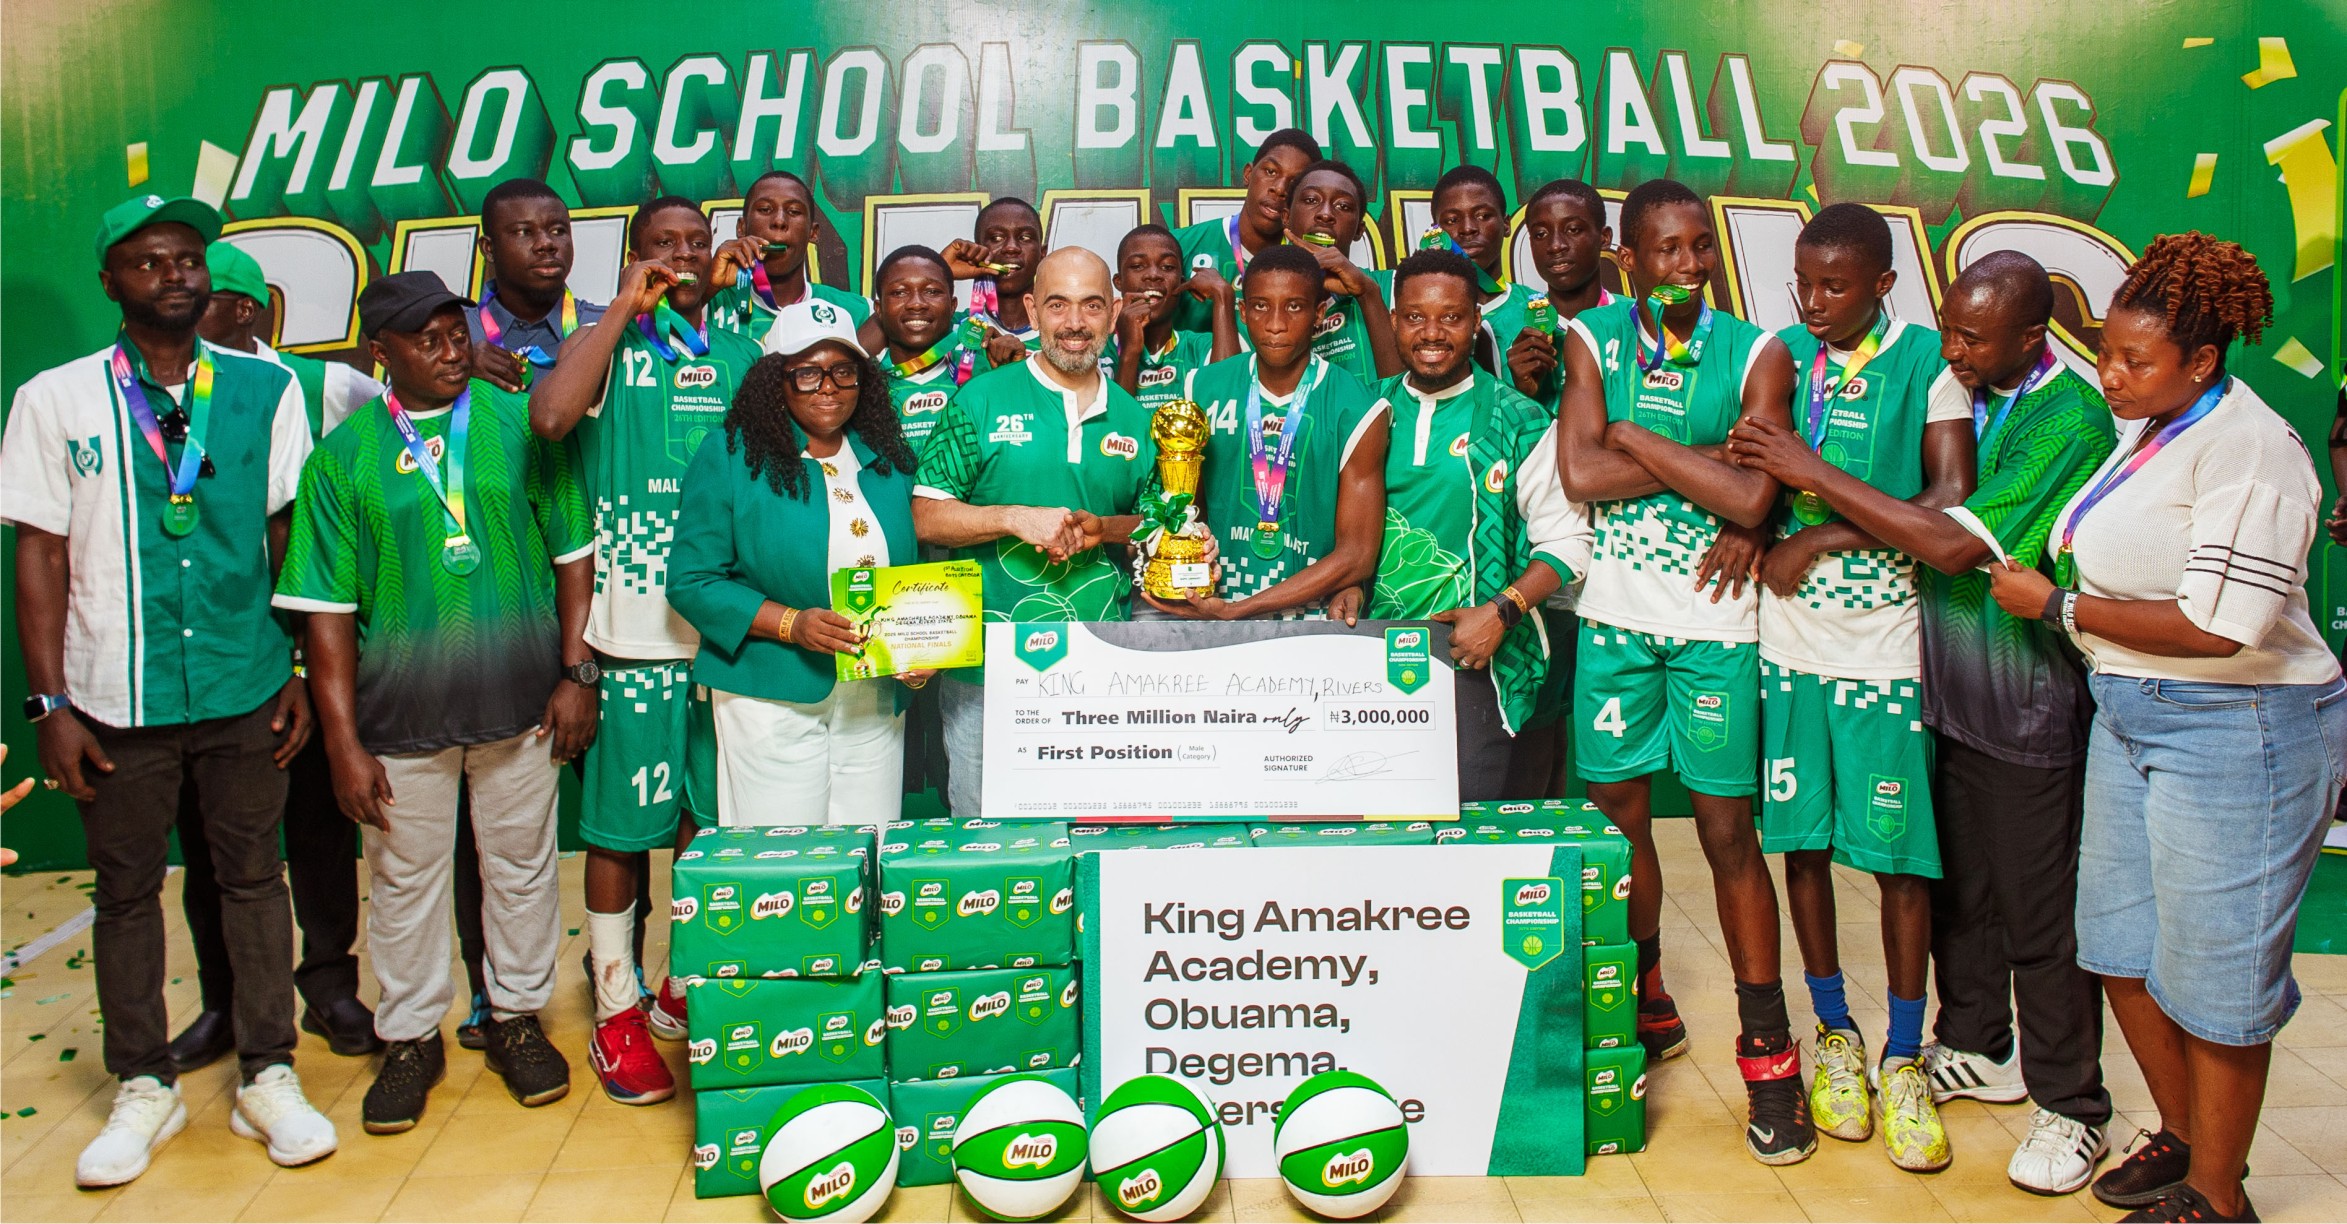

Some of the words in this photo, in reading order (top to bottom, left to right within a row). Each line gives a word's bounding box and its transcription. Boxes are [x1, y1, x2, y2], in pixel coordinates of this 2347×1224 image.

[230, 69, 529, 200] MILO
[569, 41, 1026, 171] SCHOOL
[1077, 43, 1796, 161] BASKETBALL
[1823, 63, 2116, 187] 2026
[714, 305, 740, 334] 11
[1312, 337, 1353, 352] ASKETBALL
[1319, 343, 1356, 358] MPIONSHIP
[622, 347, 657, 387] 12
[681, 372, 713, 383] MILO
[1141, 371, 1174, 384] MILO
[1648, 374, 1679, 386] MILO
[1824, 383, 1862, 395] MLO
[673, 395, 723, 405] BASKETBALL
[909, 397, 944, 411] MILO
[1135, 393, 1180, 402] BASKETBAL
[671, 404, 726, 412] CHAMPIONSHIP
[1206, 399, 1238, 436] 14
[1829, 418, 1868, 429] PIONSHIP
[900, 421, 936, 430] BASKET
[1263, 420, 1283, 432] MIL
[1828, 428, 1864, 440] EDITION
[1106, 438, 1135, 454] MILO
[404, 444, 440, 466] MO
[892, 580, 950, 595] Certificate
[890, 642, 925, 650] NATIONAL
[1029, 636, 1055, 647] MILO
[1398, 636, 1418, 645] MILO
[1038, 670, 1085, 697] KING
[1108, 671, 1210, 696] AMAKREE
[1322, 677, 1383, 696] RIVERS
[1015, 717, 1040, 725] ORDER
[1061, 710, 1119, 725] Three
[1126, 709, 1196, 724] Million
[1203, 709, 1257, 724] Naira
[1262, 707, 1311, 734] only
[1593, 697, 1627, 738] 4
[1037, 746, 1084, 760] First
[1090, 744, 1173, 760] Position
[1264, 764, 1308, 772] SIGNATURE
[631, 761, 673, 806] 12
[1519, 889, 1547, 900] MILO
[672, 904, 694, 917] ILO
[758, 898, 790, 913] MILO
[881, 898, 901, 909] ILO
[963, 897, 996, 910] MILO
[1143, 902, 1245, 941] King
[1253, 899, 1471, 933] Amakree
[1143, 949, 1379, 987] Academy,
[975, 998, 1006, 1015] MILO
[1144, 998, 1351, 1034] Obuama,
[777, 1035, 810, 1050] MILO
[695, 1151, 716, 1163] ILO
[1011, 1143, 1052, 1160] MILO
[1329, 1158, 1369, 1179] MILO
[811, 1172, 851, 1201] MILO
[1122, 1178, 1158, 1202] MILO
